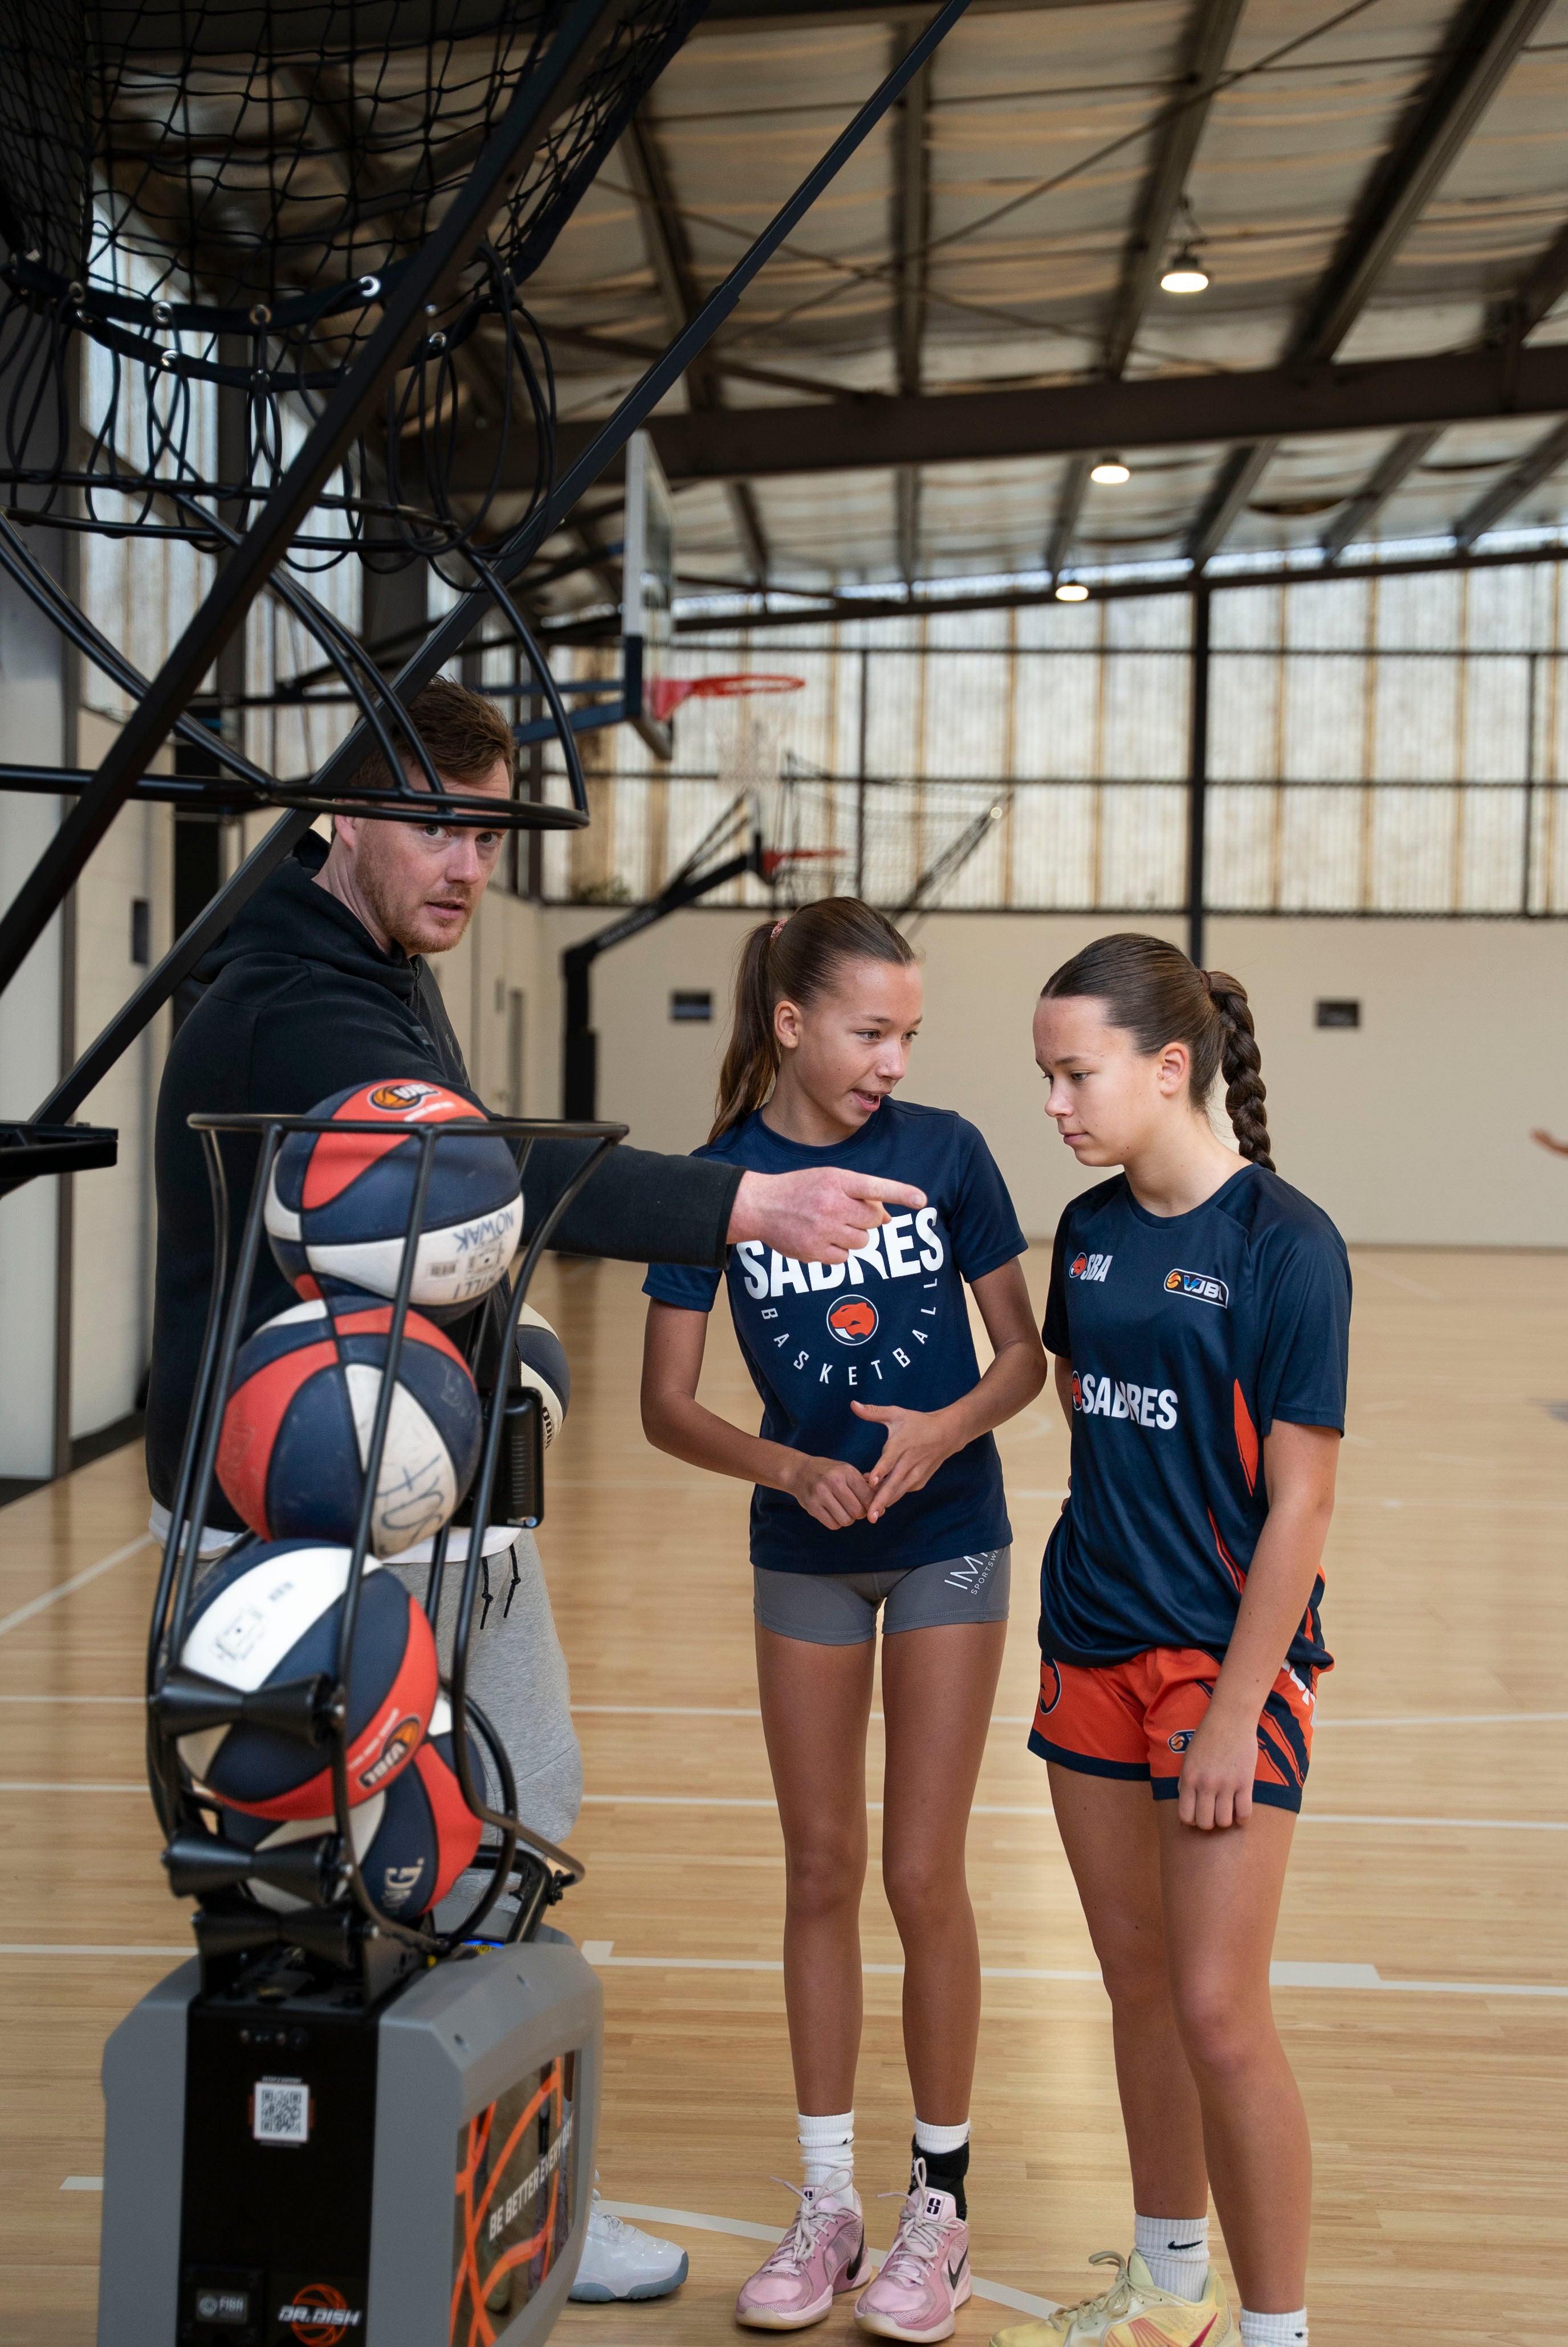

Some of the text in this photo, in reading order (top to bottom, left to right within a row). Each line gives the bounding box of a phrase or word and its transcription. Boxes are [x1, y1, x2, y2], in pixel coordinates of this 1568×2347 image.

[453, 1209, 514, 1252] NOWAK
[1080, 1254, 1113, 1282] SBA
[761, 1278, 938, 1386] BASKETBALL
[1081, 1373, 1179, 1430] SABRES
[489, 2205, 504, 2242] BE
[506, 2166, 539, 2226] BETTER
[540, 2132, 561, 2185] EVERY
